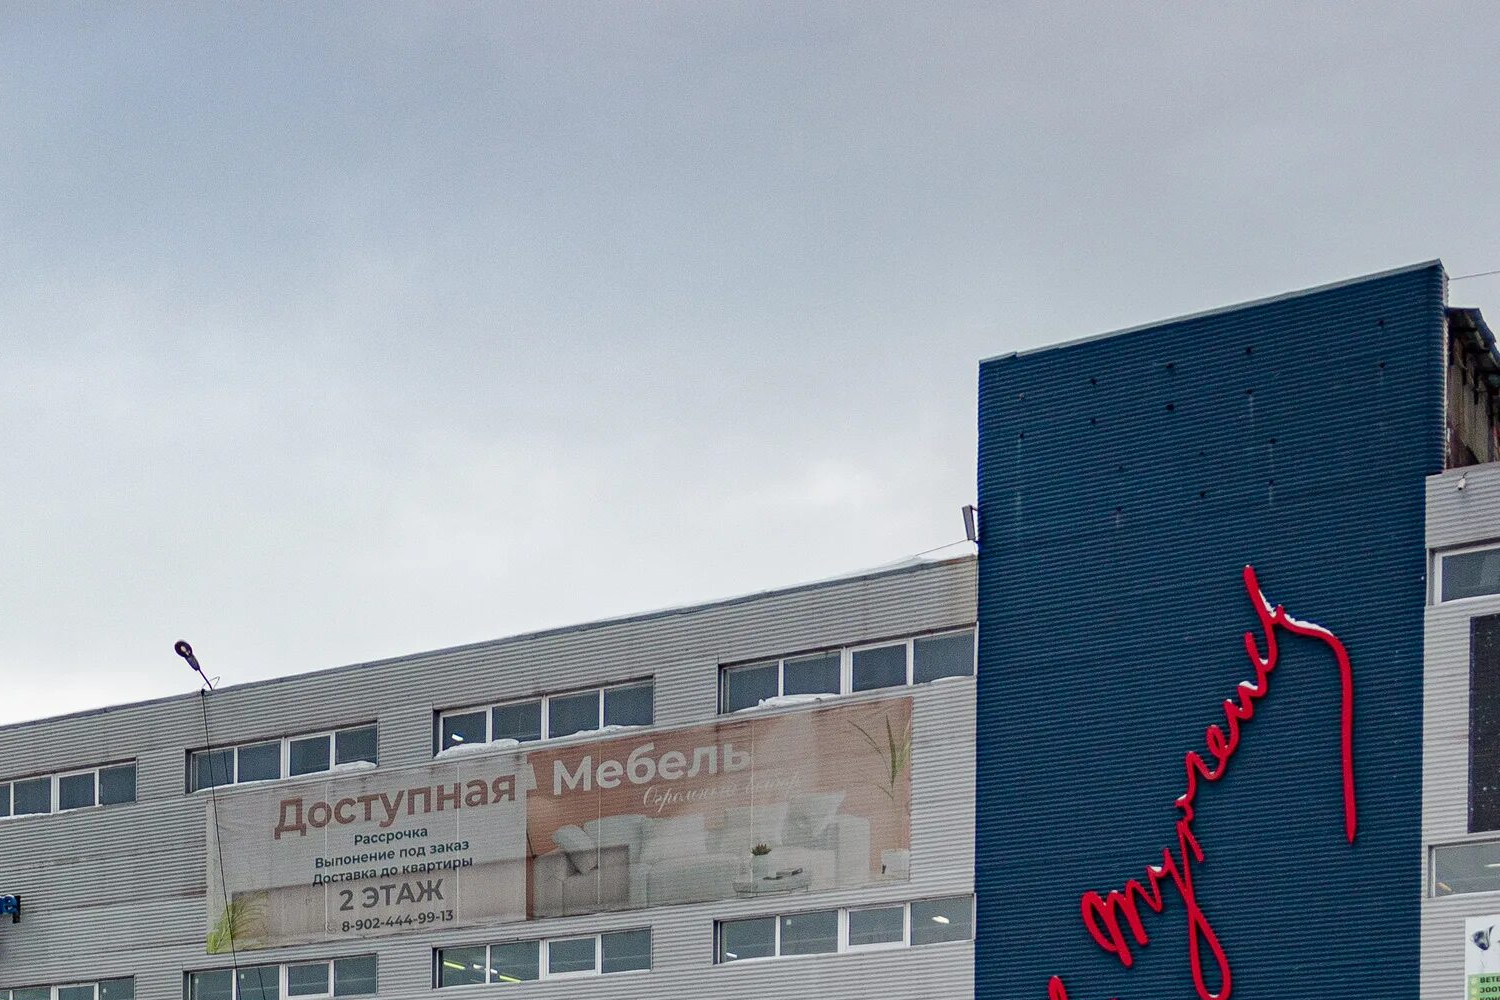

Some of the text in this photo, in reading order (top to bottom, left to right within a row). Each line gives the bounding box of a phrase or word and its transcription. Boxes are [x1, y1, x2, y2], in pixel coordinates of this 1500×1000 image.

[553, 742, 752, 796] Мебель
[274, 774, 516, 840] Доступная
[354, 828, 428, 846] Рассрочка
[315, 840, 470, 868] Выпонение под заказ
[312, 856, 473, 887] Доставка до квартиры
[339, 878, 444, 911] 2 ЭТАЖ
[342, 909, 454, 932] 8-902-444-99-13
